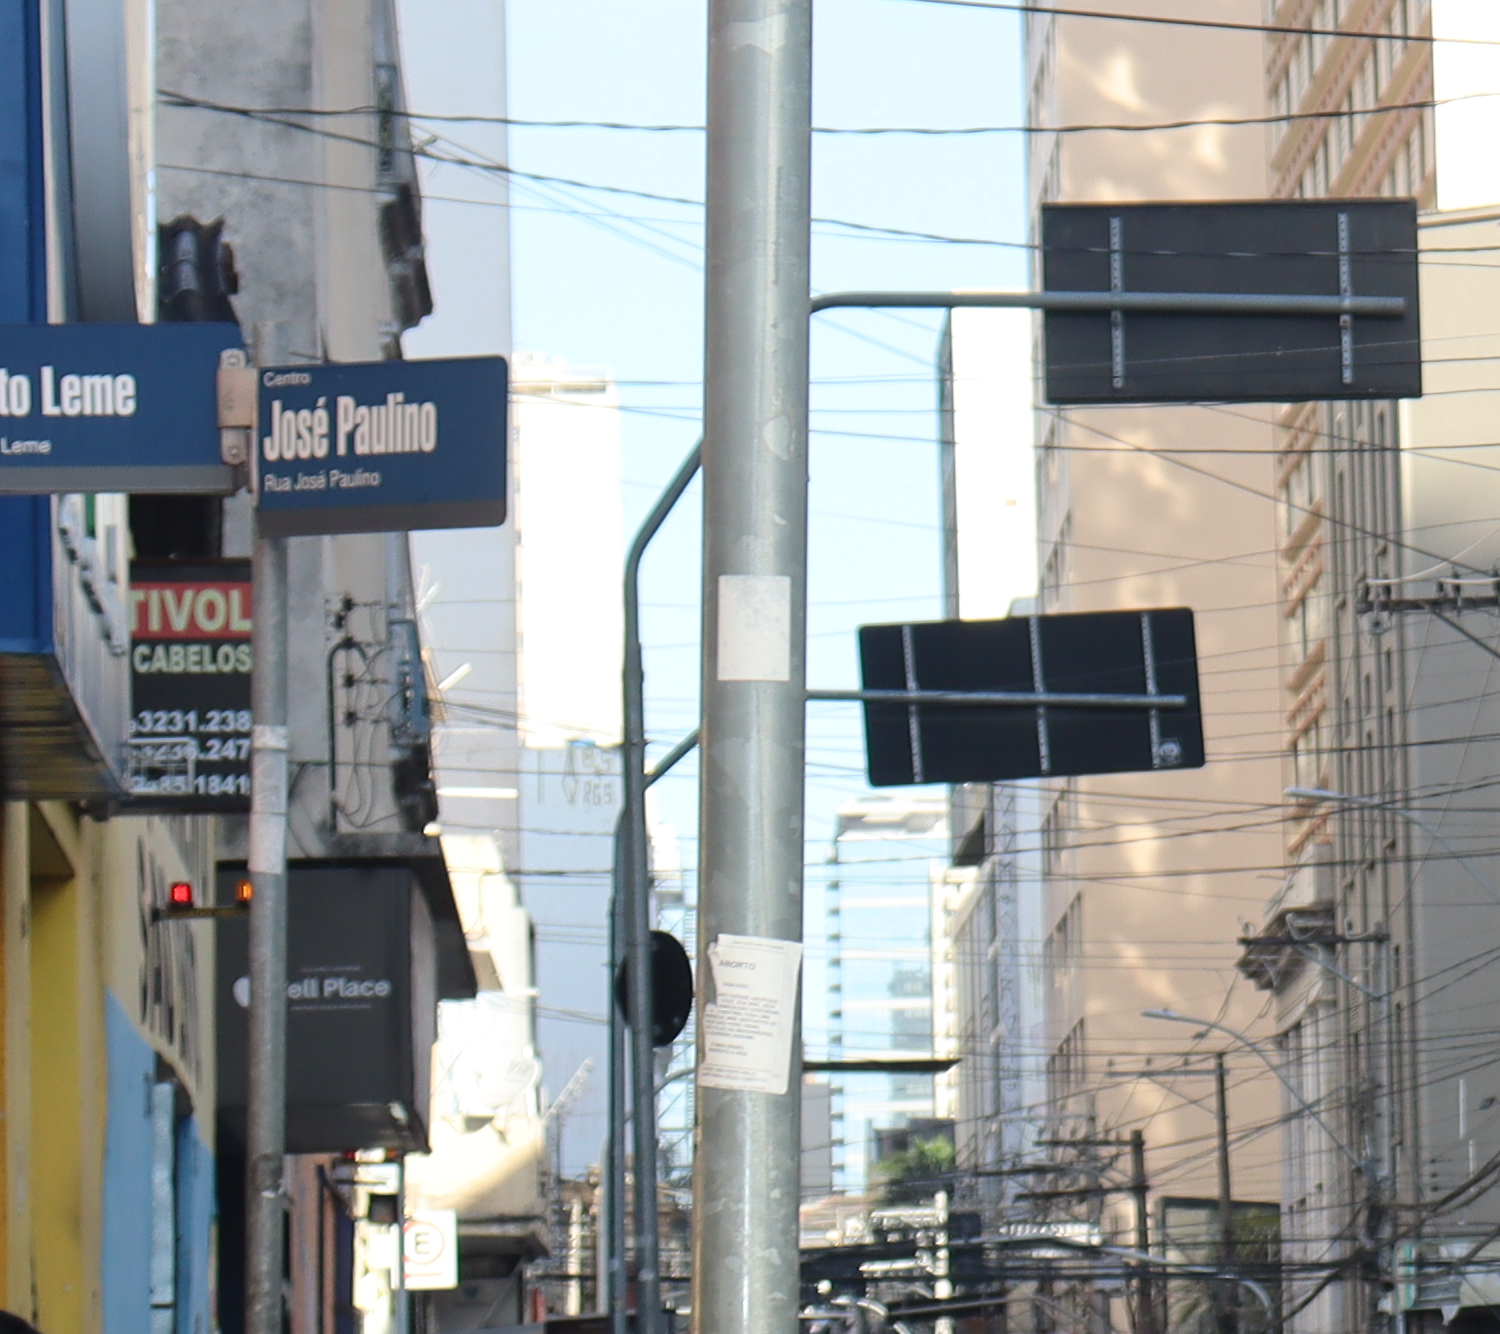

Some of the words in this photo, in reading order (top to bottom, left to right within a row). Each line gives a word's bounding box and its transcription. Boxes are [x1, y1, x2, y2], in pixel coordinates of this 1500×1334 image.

[263, 371, 311, 386] Centro
[41, 366, 136, 417] Leme
[263, 397, 328, 462] José
[336, 393, 438, 457] Paulino
[1, 439, 51, 454] Leme
[264, 474, 291, 492] Rua
[293, 470, 327, 490] José
[329, 468, 381, 488] Paulino
[133, 643, 251, 674] CABELOS
[285, 978, 318, 999] ell
[323, 977, 392, 998] Place
[415, 1232, 430, 1254] E
